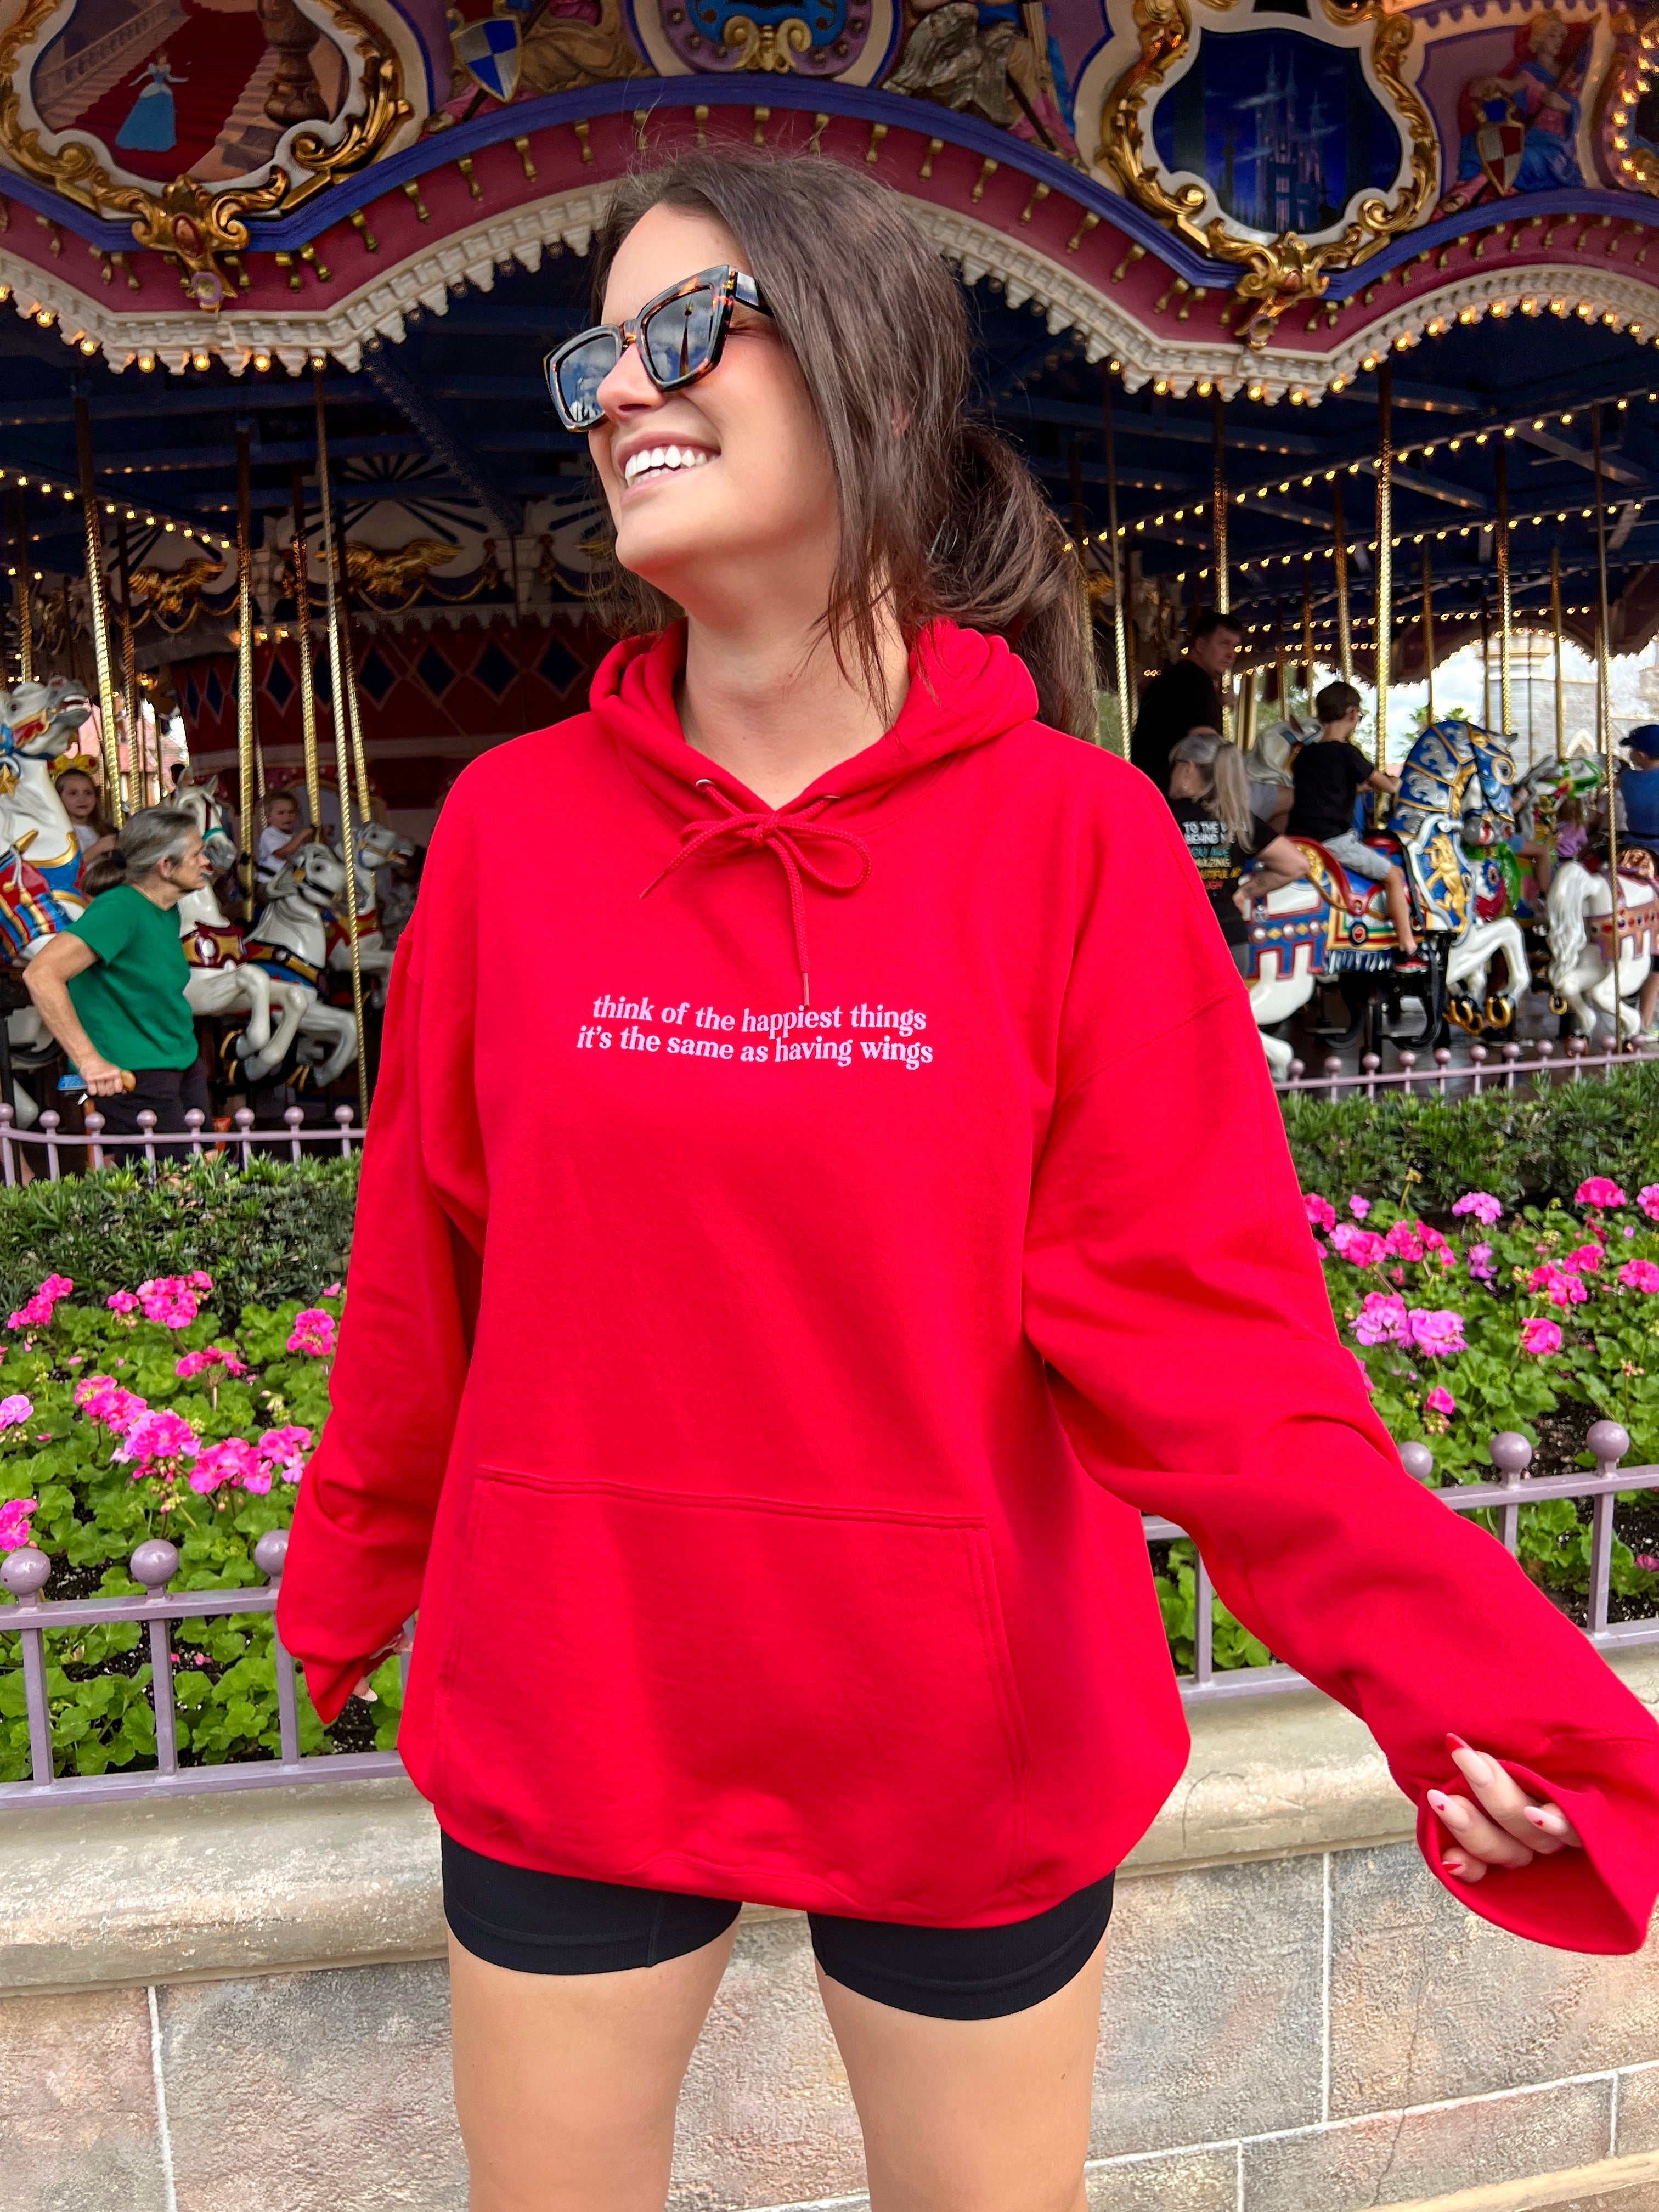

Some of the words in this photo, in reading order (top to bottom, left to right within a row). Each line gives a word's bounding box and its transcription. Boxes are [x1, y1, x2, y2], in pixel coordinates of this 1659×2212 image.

[1183, 821, 1199, 833] TO
[1200, 821, 1219, 833] THE
[1185, 833, 1220, 844] BEHIND
[1189, 846, 1207, 857] OU
[594, 995, 654, 1021] think
[662, 1002, 690, 1025] of
[696, 1007, 735, 1031] the
[741, 1005, 843, 1039] happiest
[850, 1003, 926, 1037] things
[620, 1026, 661, 1052] the
[667, 1037, 734, 1059] same
[740, 1046, 768, 1062] as
[775, 1036, 853, 1067] having
[860, 1035, 933, 1070] wings
